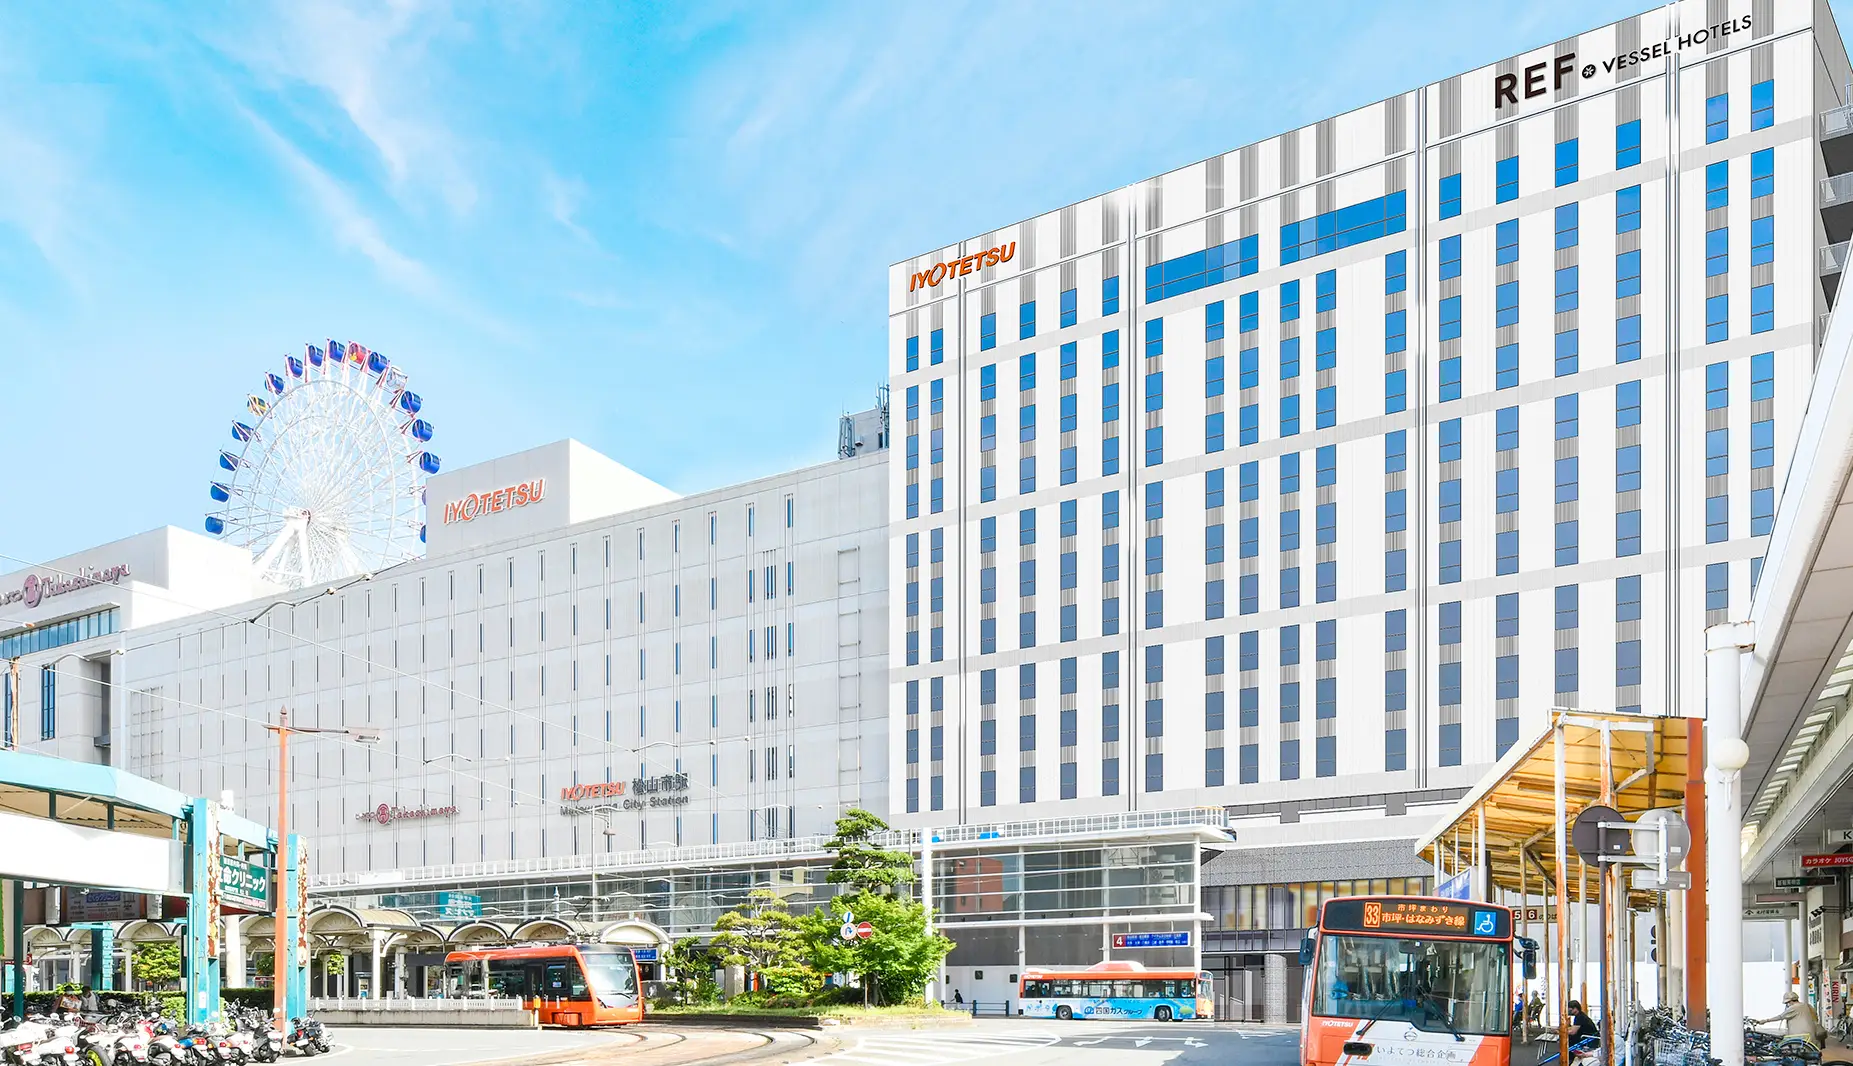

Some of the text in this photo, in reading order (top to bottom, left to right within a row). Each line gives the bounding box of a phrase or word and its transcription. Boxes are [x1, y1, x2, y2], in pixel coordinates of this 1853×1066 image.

[1494, 14, 1752, 110] REF VESSEL HOTELS
[909, 241, 1016, 293] IYOTETSU
[443, 479, 546, 524] IYOTETSU
[560, 772, 689, 801] IYOTETSU 松山市駅
[623, 799, 645, 811] City
[649, 795, 689, 808] Station
[1365, 903, 1449, 925] 33 市坪まわり
[1514, 910, 1521, 919] 5
[1528, 910, 1536, 919] 6
[1116, 936, 1123, 946] 4
[1096, 1006, 1142, 1015] 四国ガスグループ
[1321, 1020, 1354, 1028] IYOTETSU
[1377, 1046, 1456, 1060] いよてつ総合企画
